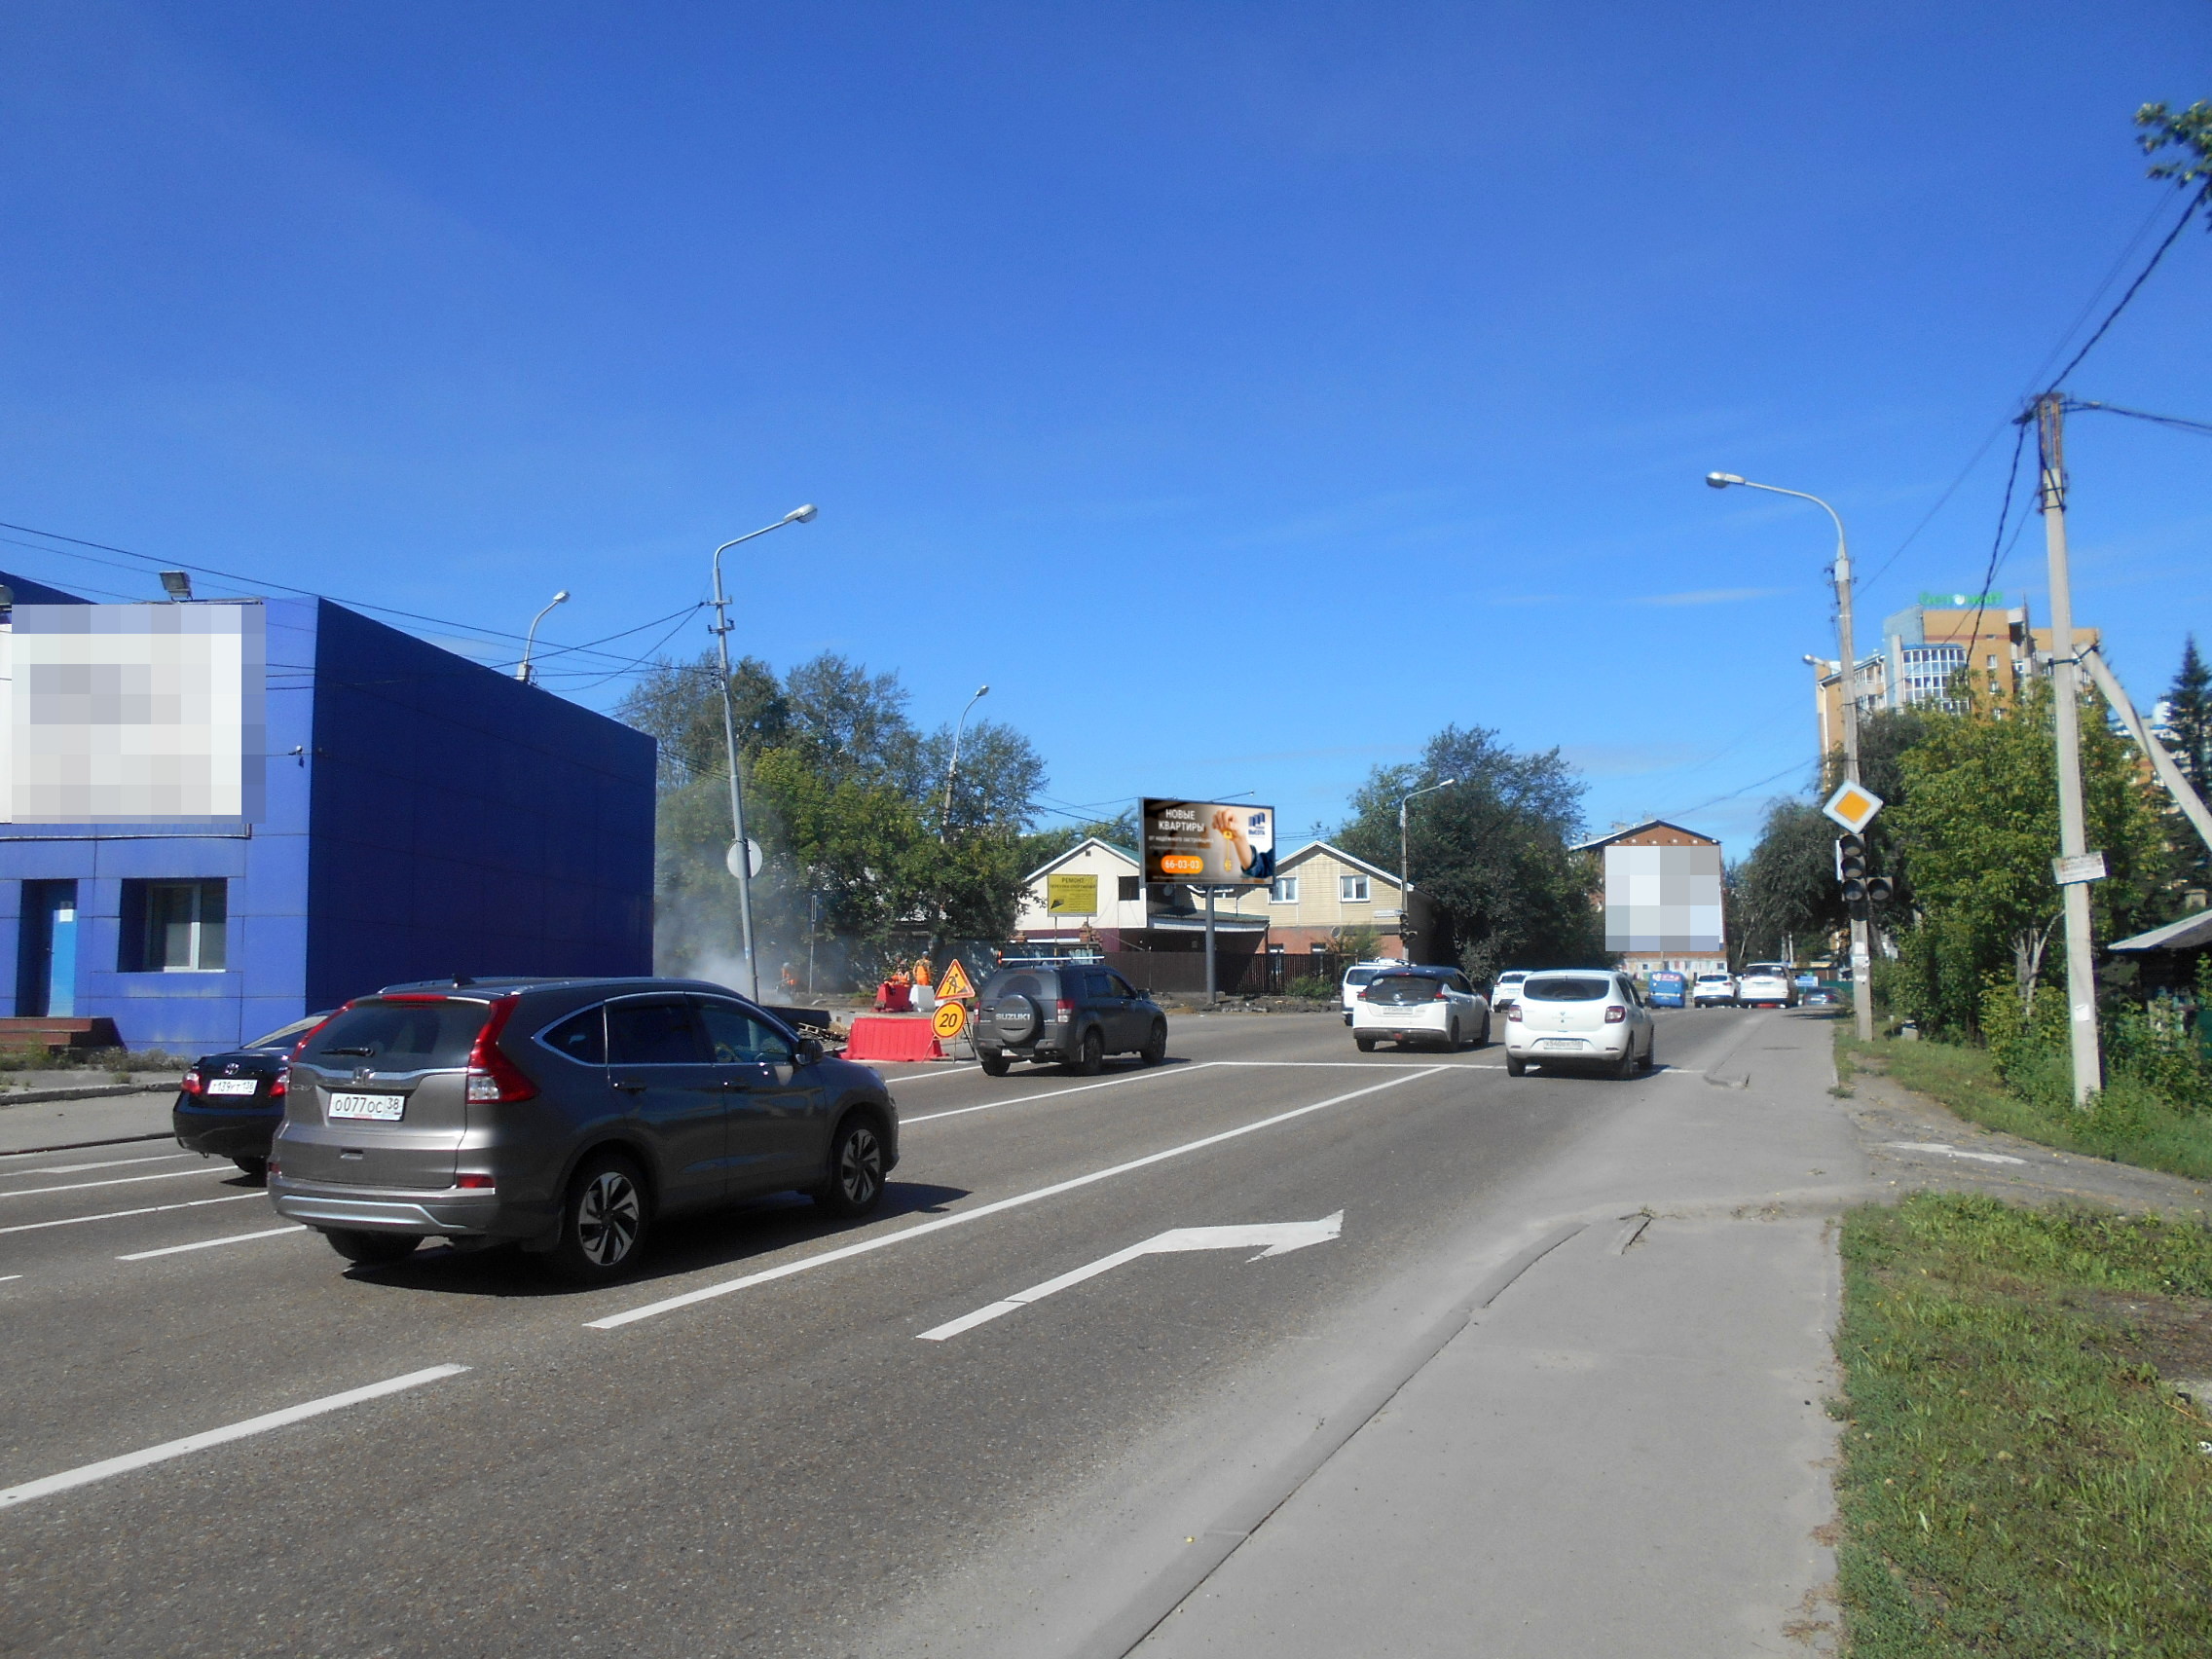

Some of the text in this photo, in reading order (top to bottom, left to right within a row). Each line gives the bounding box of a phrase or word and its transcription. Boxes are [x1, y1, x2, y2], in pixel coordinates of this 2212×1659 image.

[1165, 808, 1196, 820] НОВЫЕ
[1158, 820, 1205, 832] КВАРТИРЫ
[1164, 860, 1200, 869] 66-03-03
[939, 1014, 958, 1028] 20
